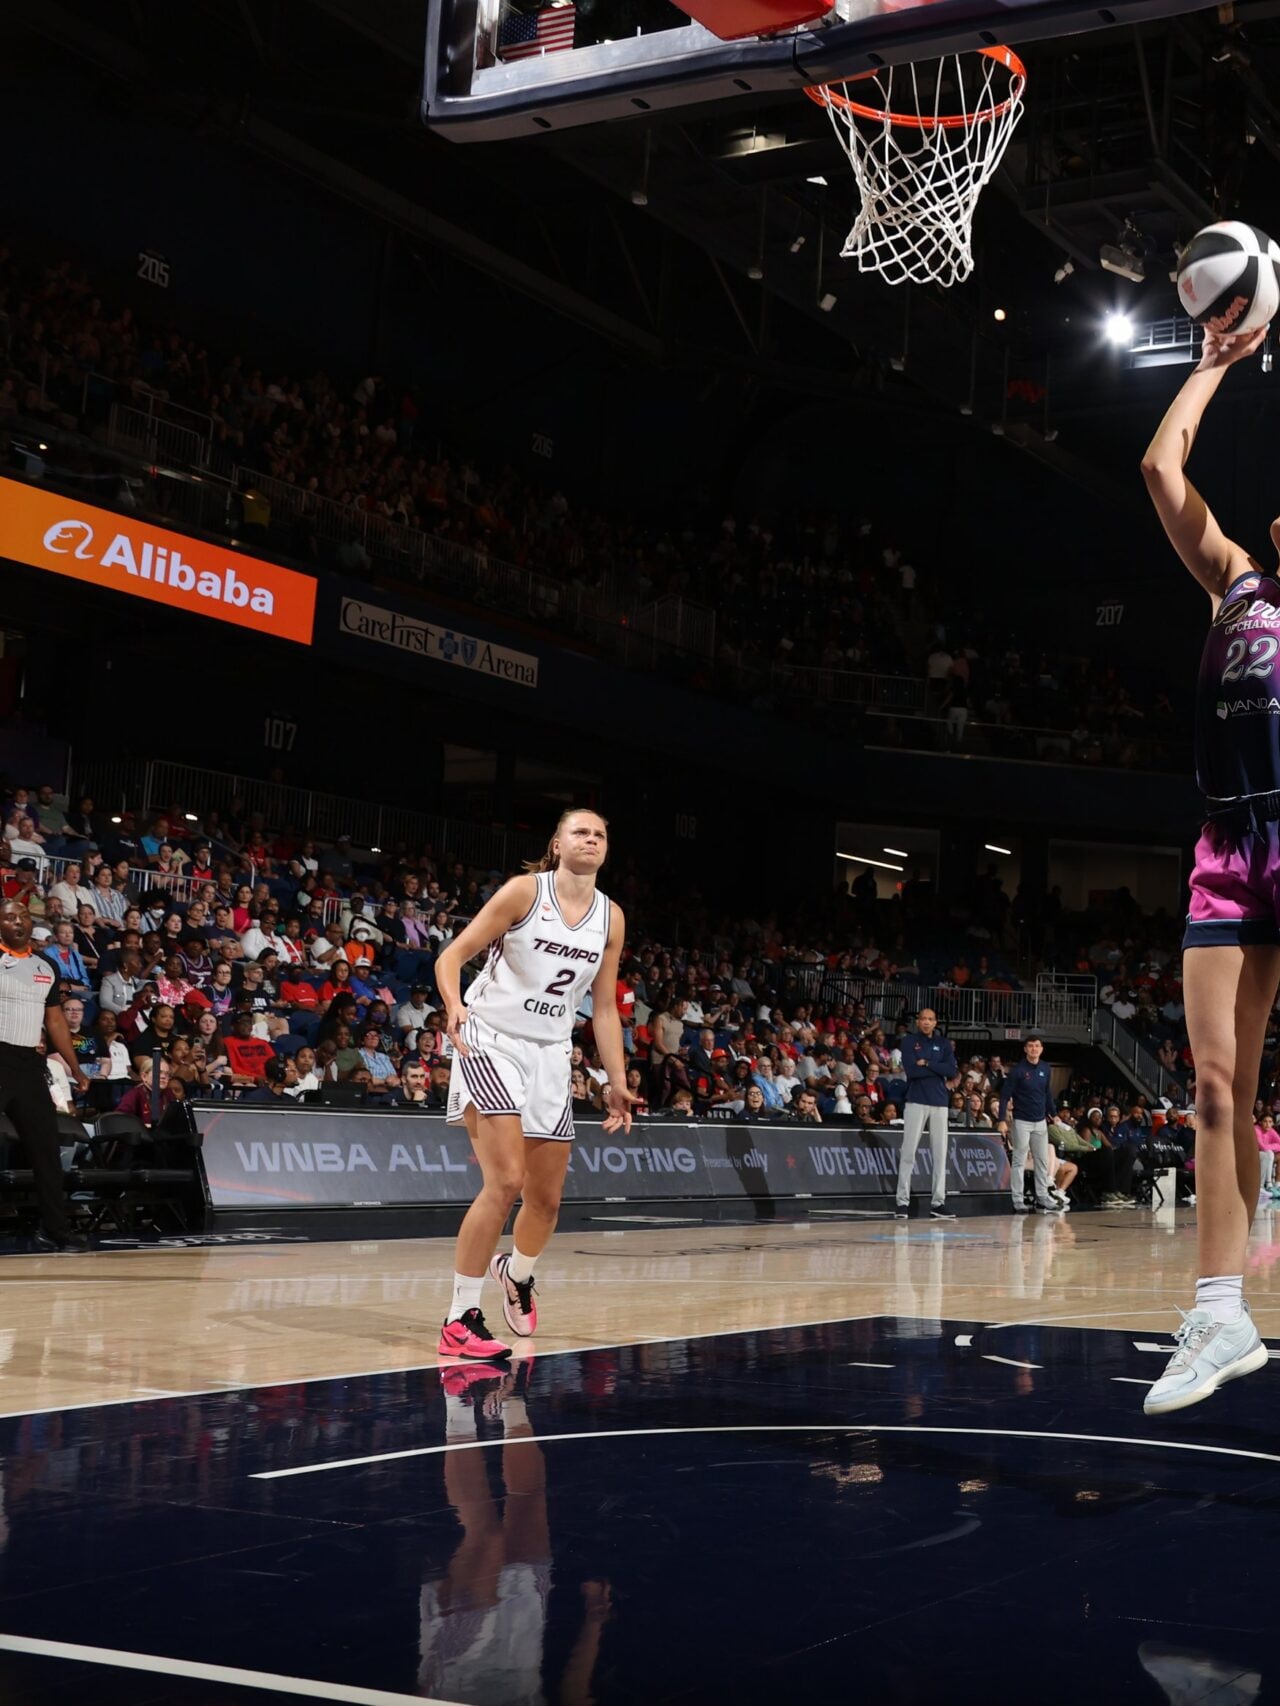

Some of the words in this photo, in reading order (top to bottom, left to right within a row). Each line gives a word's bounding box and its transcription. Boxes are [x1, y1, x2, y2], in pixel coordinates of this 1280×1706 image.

[137, 252, 170, 288] 205
[100, 534, 274, 616] Alibaba
[1096, 604, 1124, 626] 207
[342, 602, 435, 654] CareFirst
[478, 644, 535, 684] Arena
[1220, 634, 1280, 686] 22
[264, 717, 297, 751] 107
[533, 938, 600, 963] TEMPO
[545, 969, 575, 996] 2
[235, 1141, 378, 1174] WNBA
[388, 1143, 468, 1174] ALL
[576, 1145, 697, 1174] VOTING
[743, 1147, 768, 1173] ally
[808, 1146, 855, 1176] VOTE
[856, 1147, 901, 1176] DAILY
[960, 1148, 994, 1160] WNBA
[967, 1161, 997, 1177] APP
